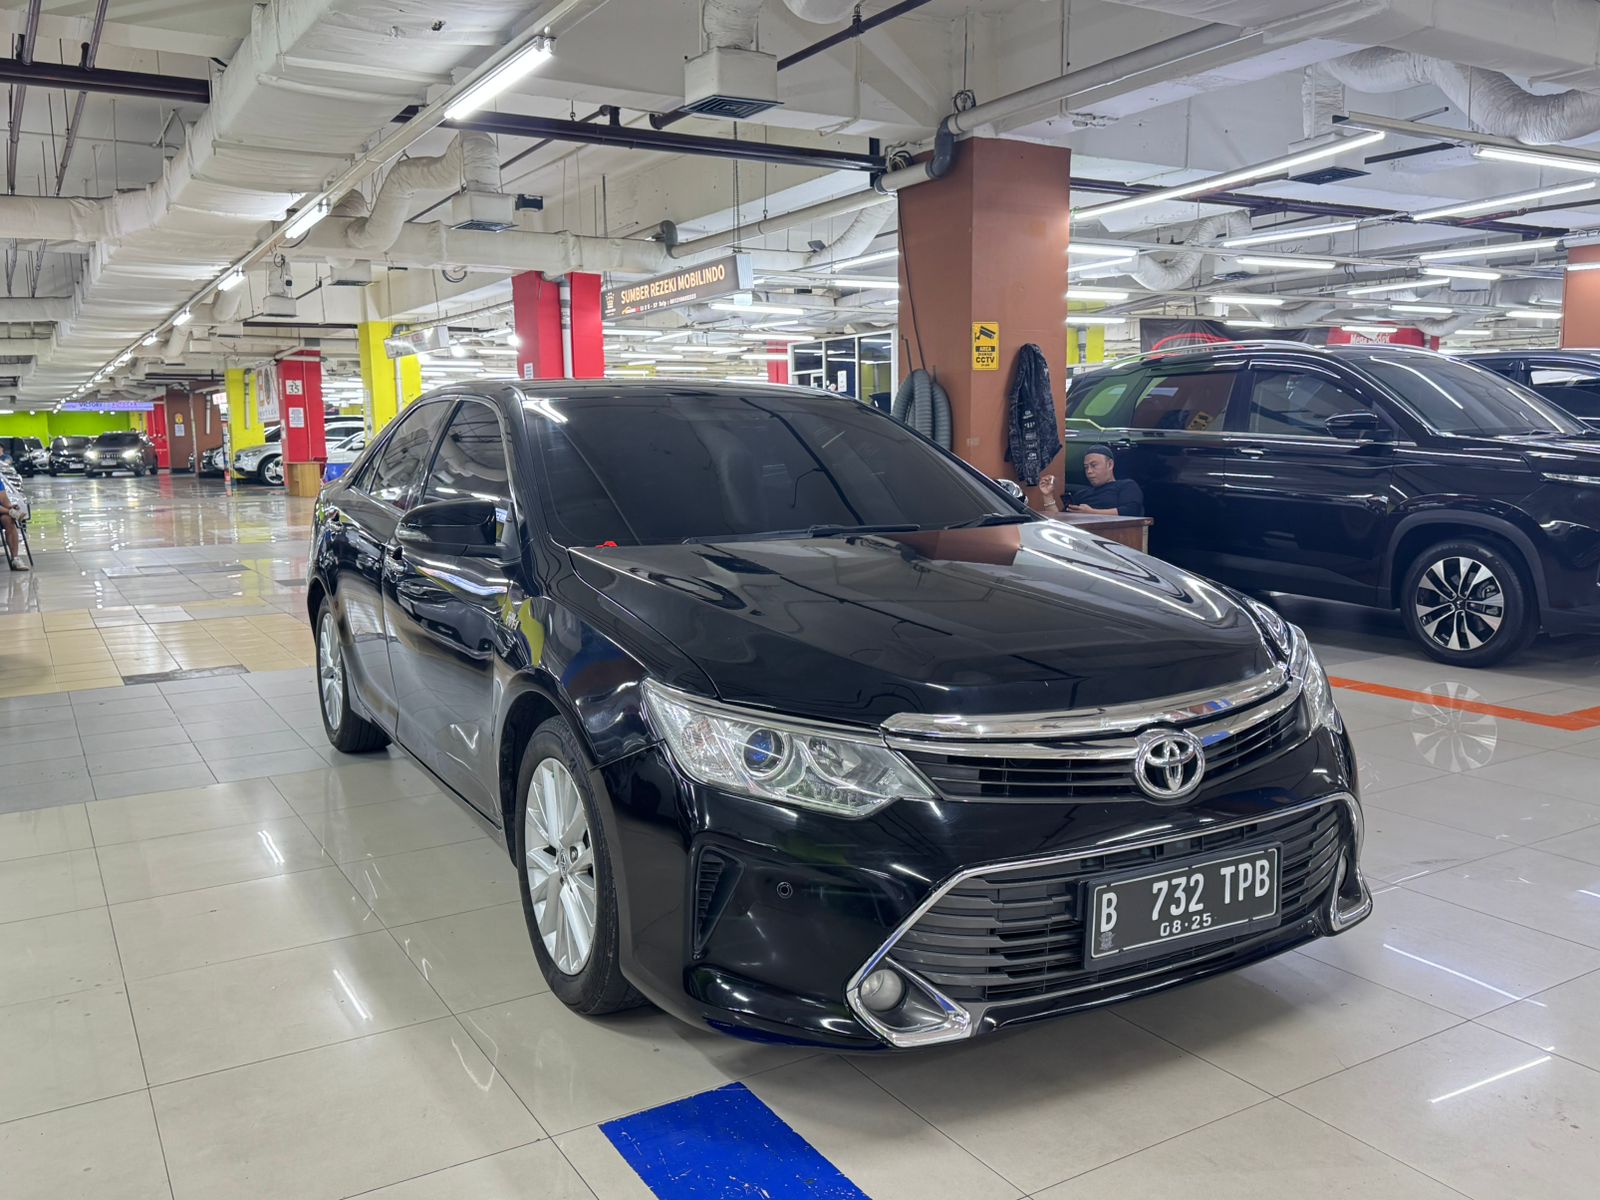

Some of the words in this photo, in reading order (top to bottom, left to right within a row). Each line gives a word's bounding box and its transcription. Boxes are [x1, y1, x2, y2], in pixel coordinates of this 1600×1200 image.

[621, 284, 650, 304] SUMBER
[650, 277, 677, 298] REZEKI
[678, 264, 725, 291] MOBILINDO
[1100, 892, 1118, 933] B
[1151, 873, 1205, 921] 732
[1220, 859, 1270, 904] TPB
